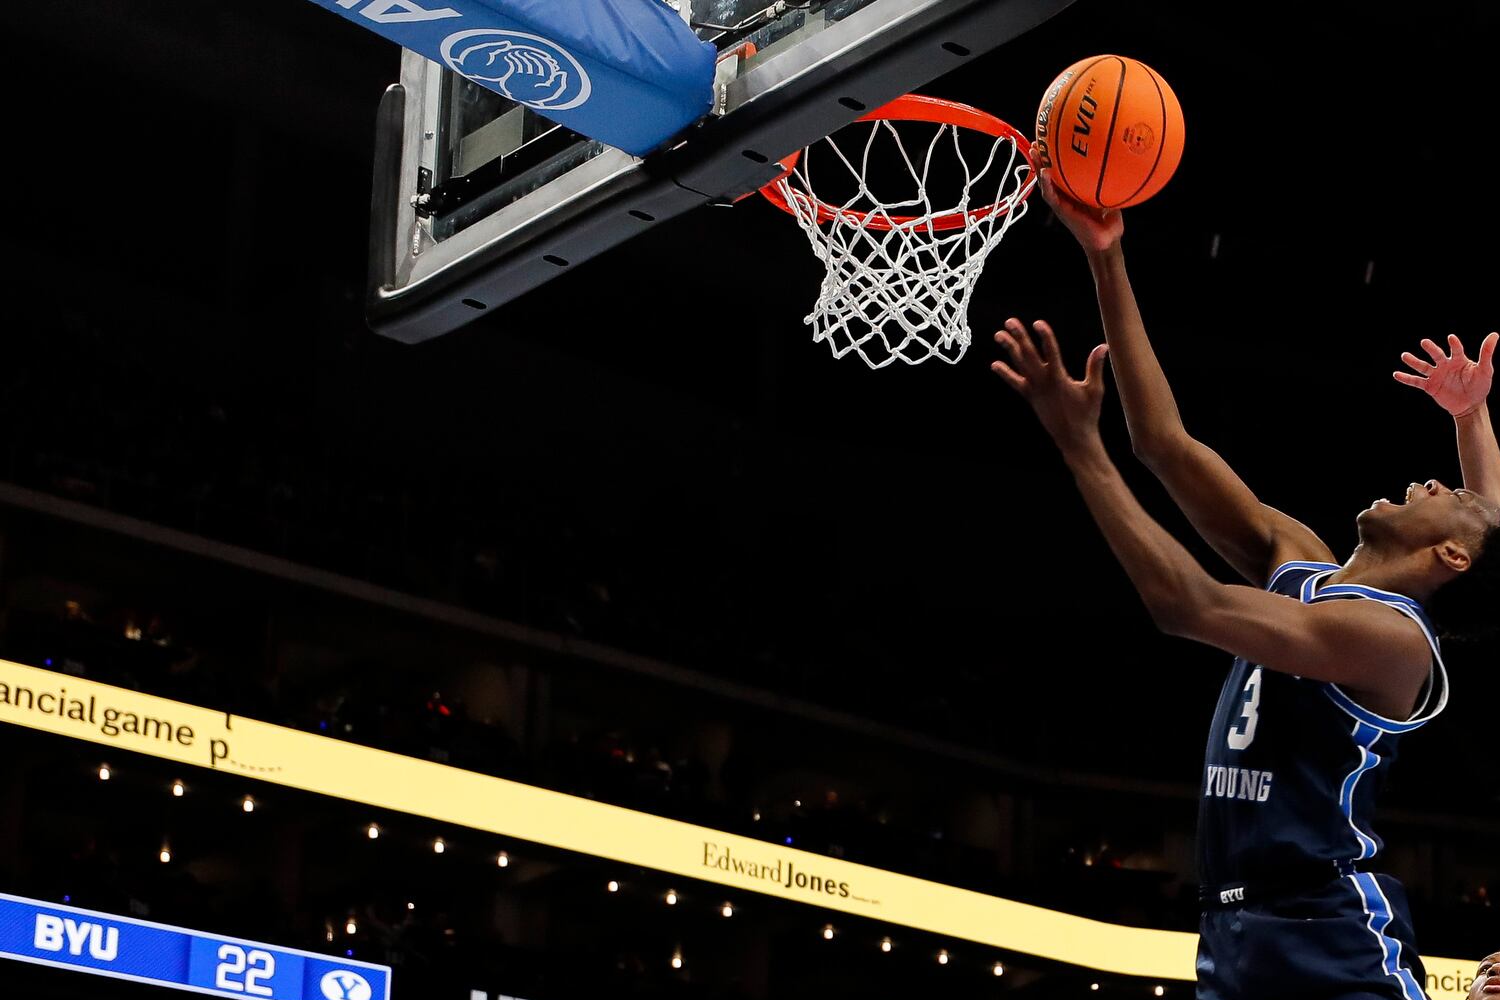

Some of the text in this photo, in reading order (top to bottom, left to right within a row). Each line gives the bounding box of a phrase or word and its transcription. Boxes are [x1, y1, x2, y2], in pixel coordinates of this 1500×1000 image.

[1071, 95, 1098, 158] EVO
[100, 705, 195, 746] game
[1227, 668, 1262, 750] 3
[1205, 764, 1274, 801] YOUNG
[702, 841, 850, 899] Edward Jones
[1220, 887, 1245, 904] BYU
[33, 912, 120, 962] BYU
[215, 943, 276, 997] 22
